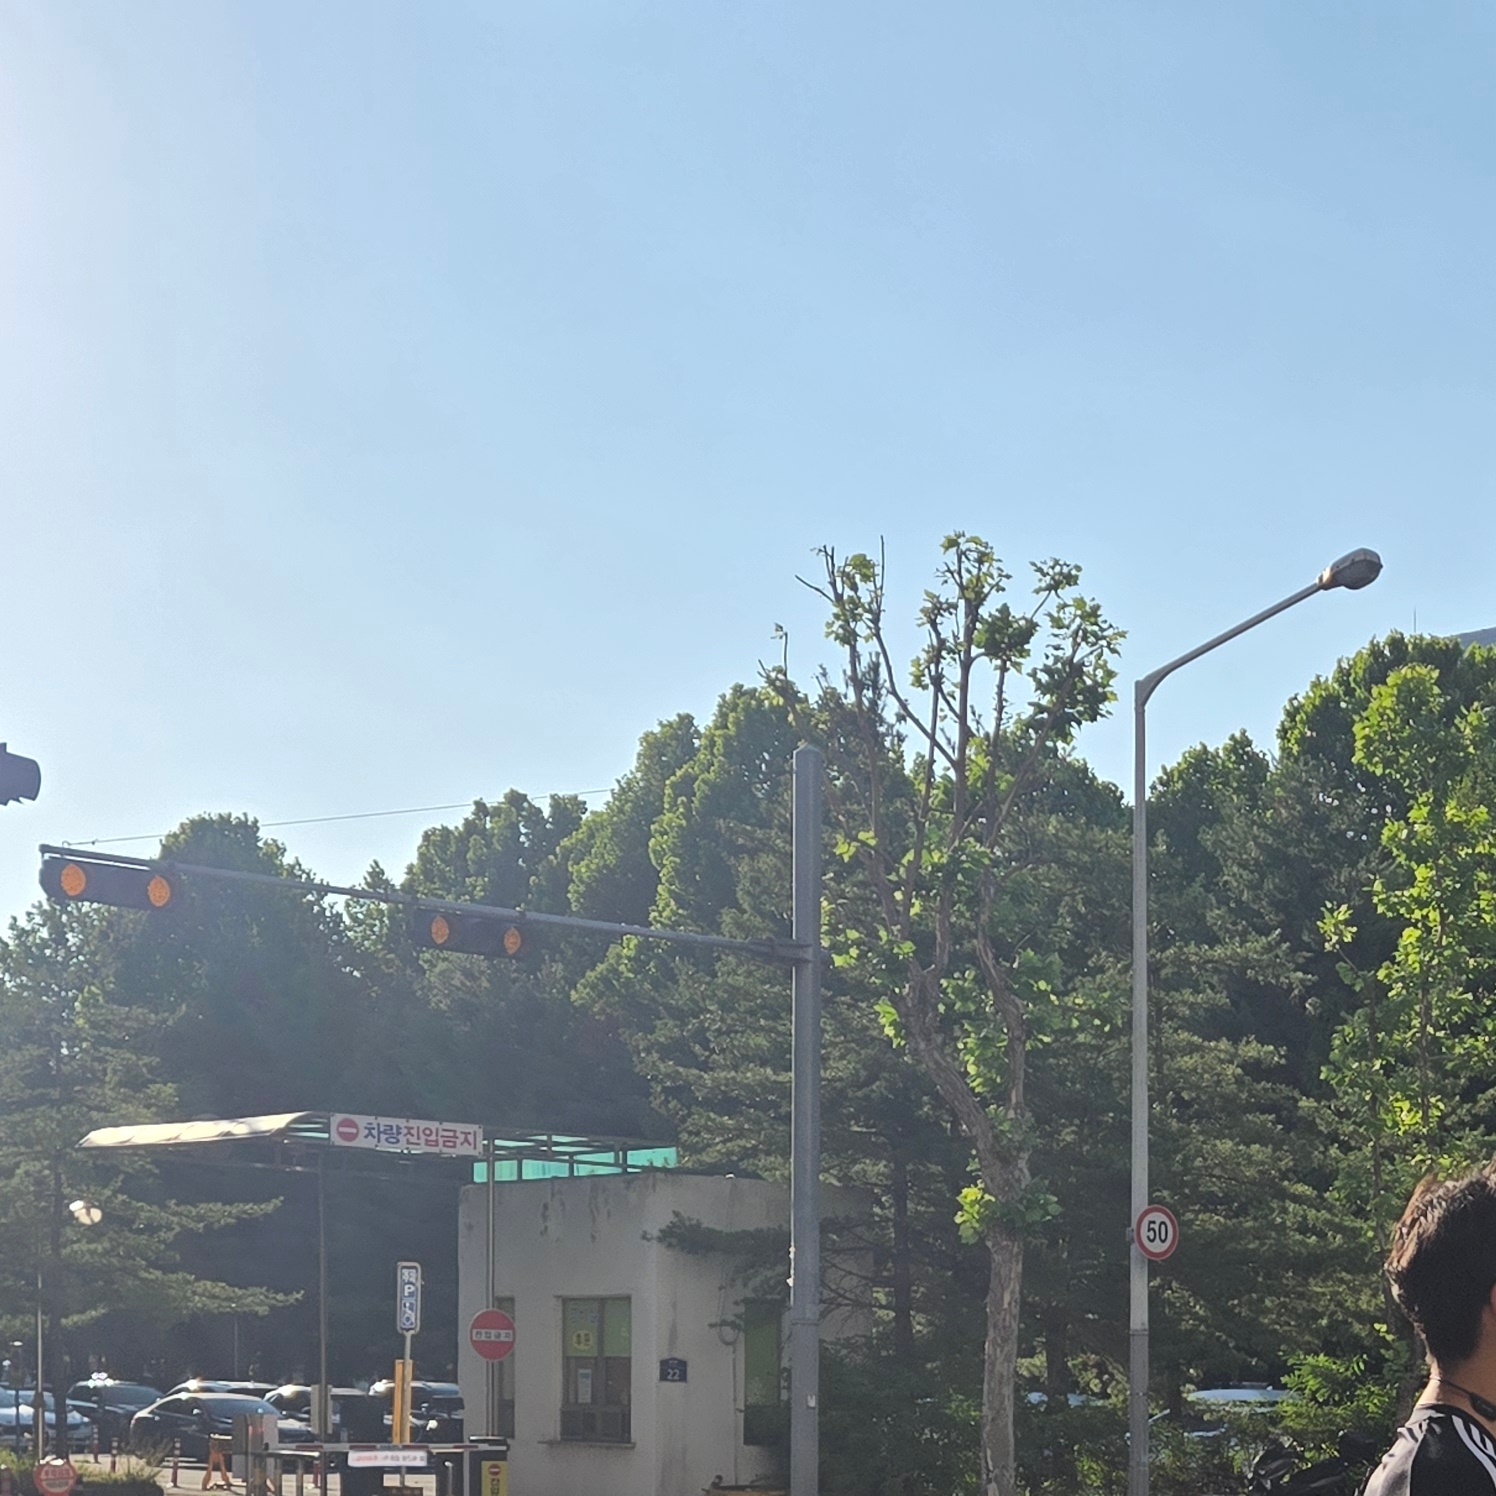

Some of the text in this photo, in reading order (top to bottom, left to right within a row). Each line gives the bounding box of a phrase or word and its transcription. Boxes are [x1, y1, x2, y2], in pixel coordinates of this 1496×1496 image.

[363, 1122, 477, 1150] 차량진입금지
[1146, 1220, 1168, 1243] 50
[404, 1284, 415, 1296] P
[666, 1368, 680, 1380] 22
